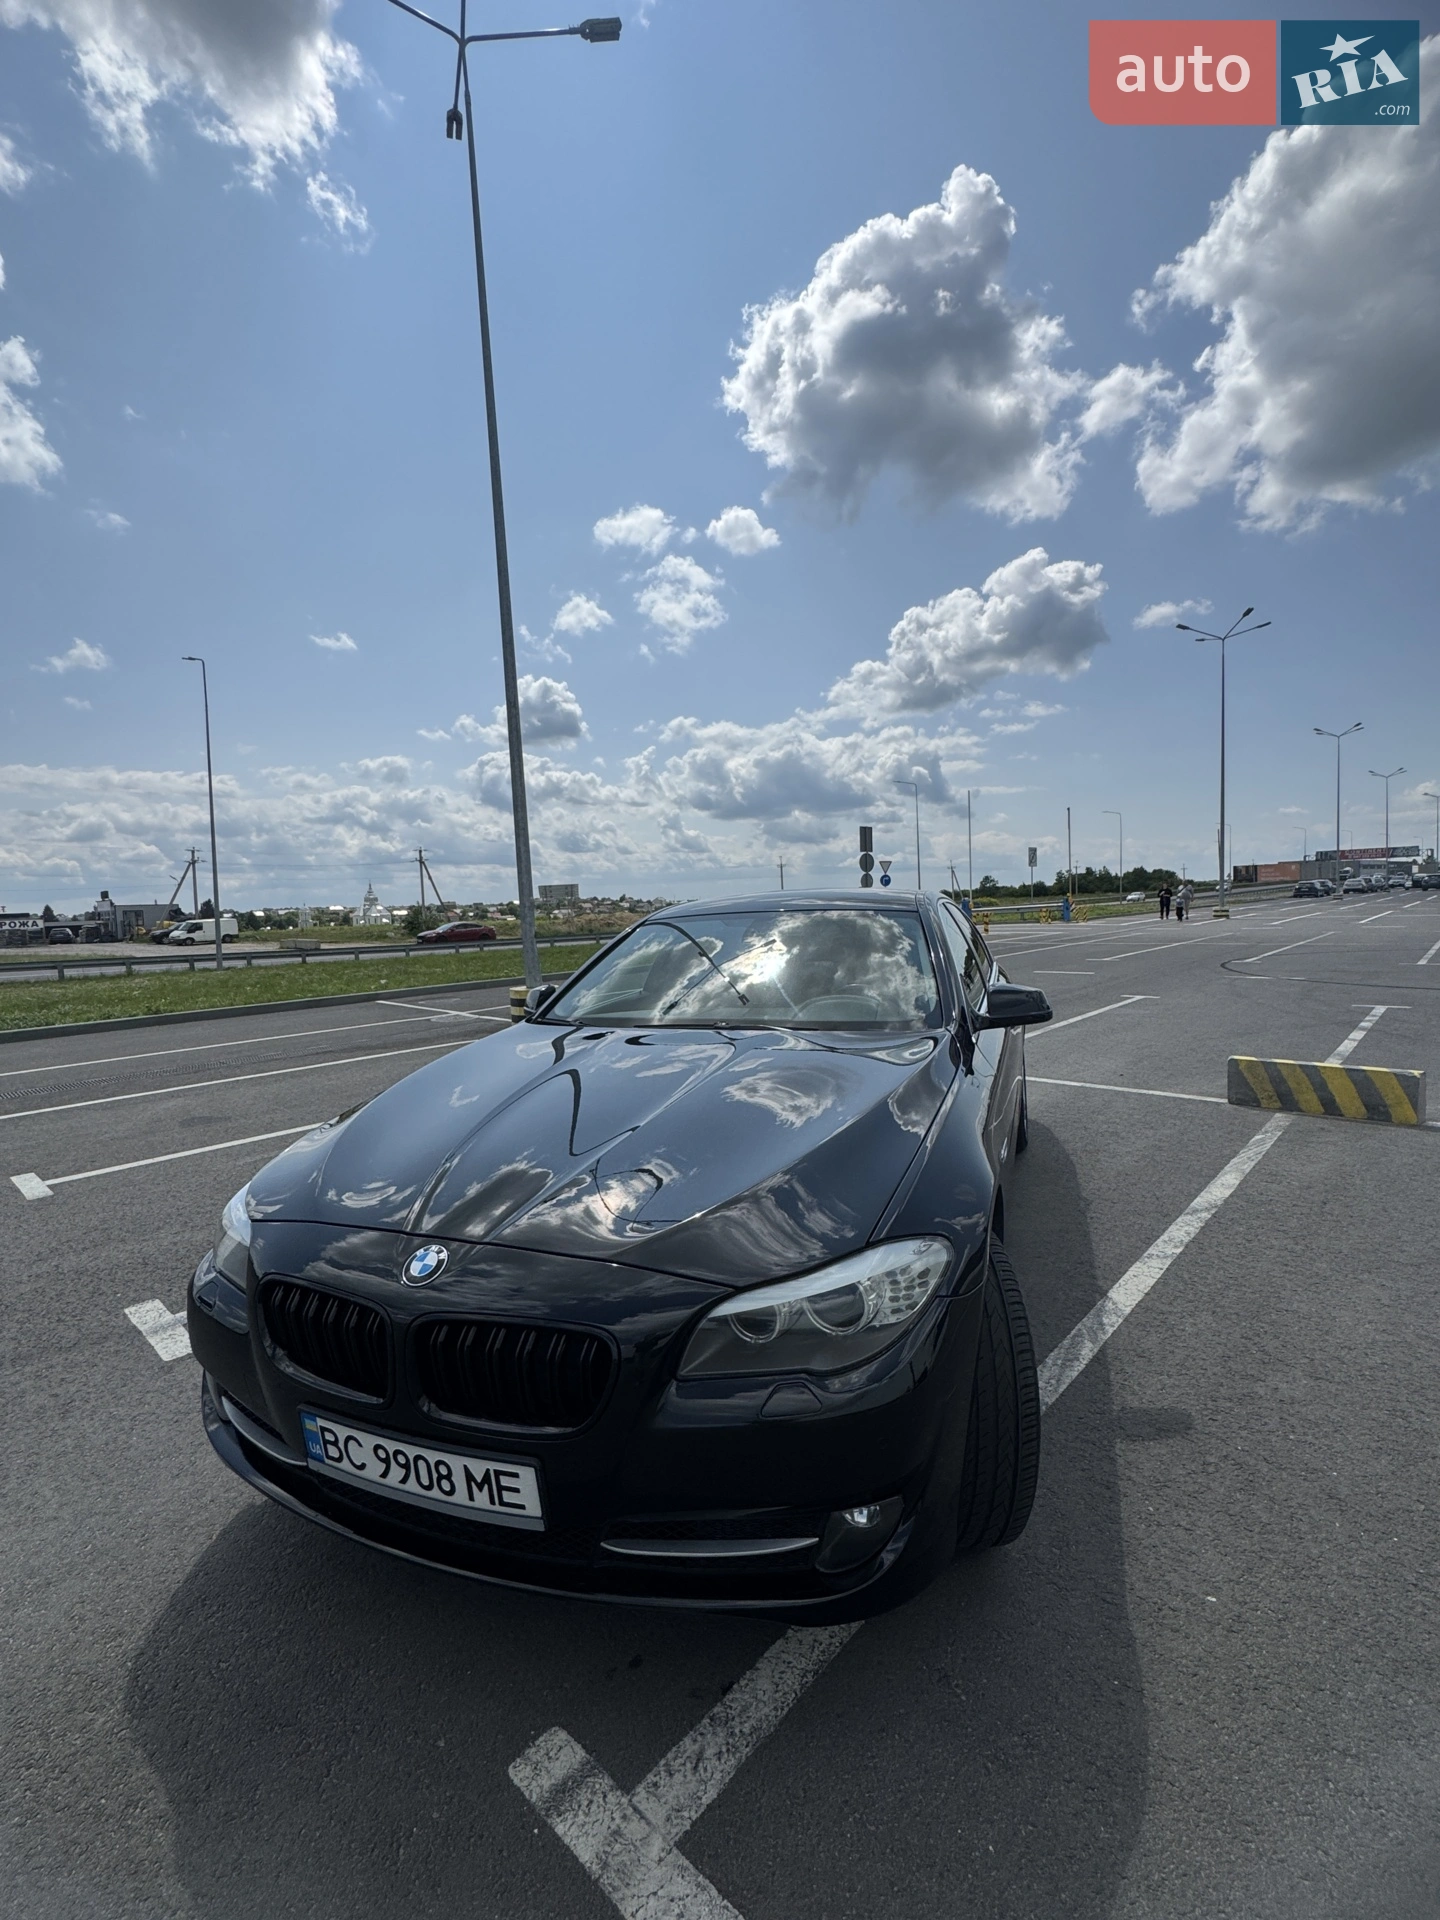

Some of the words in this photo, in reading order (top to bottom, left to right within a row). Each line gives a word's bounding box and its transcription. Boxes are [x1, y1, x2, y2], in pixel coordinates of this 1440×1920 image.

[308, 1440, 323, 1456] UA
[319, 1424, 367, 1471] BC
[372, 1443, 457, 1497] 9908
[463, 1463, 527, 1510] ME
